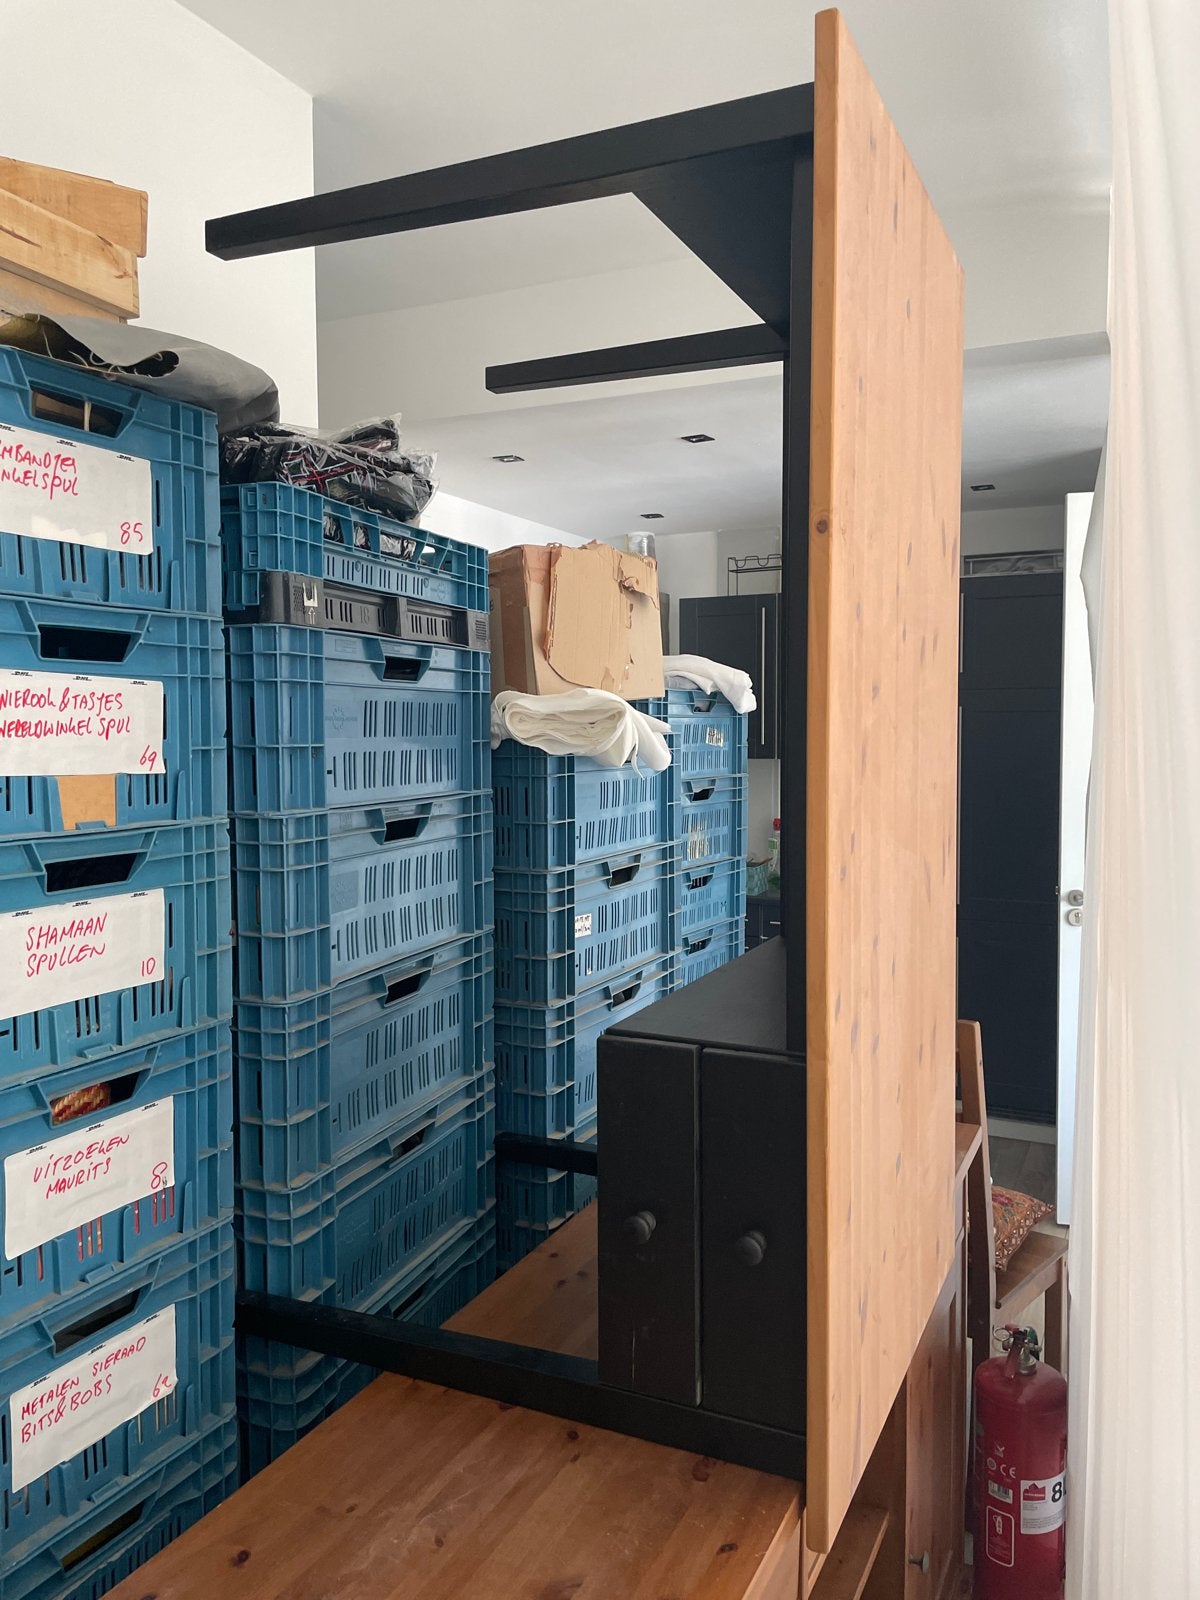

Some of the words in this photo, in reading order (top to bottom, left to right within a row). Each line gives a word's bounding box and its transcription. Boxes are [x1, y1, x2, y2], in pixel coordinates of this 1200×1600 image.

[120, 522, 143, 545] 85
[139, 745, 157, 771] 69
[26, 912, 108, 951] SHAMAAN
[26, 943, 106, 978] SPULLEN
[141, 957, 156, 977] 10
[21, 1376, 79, 1420] METALEN
[93, 1336, 146, 1376] SIERAAD
